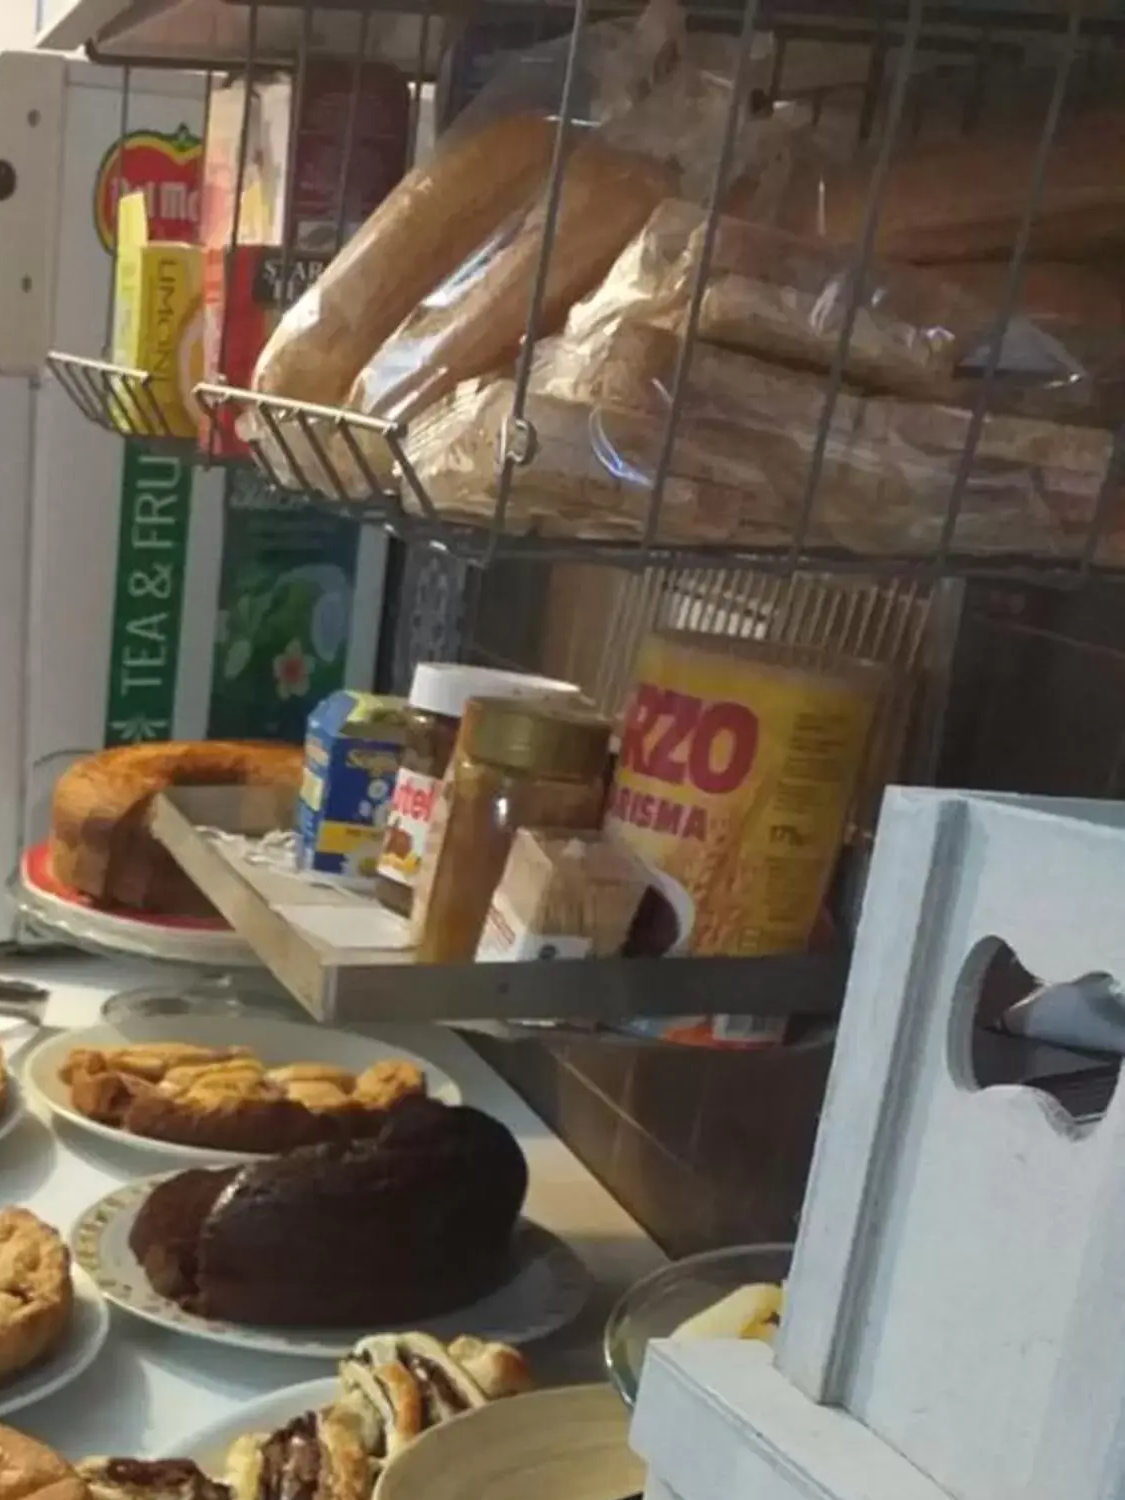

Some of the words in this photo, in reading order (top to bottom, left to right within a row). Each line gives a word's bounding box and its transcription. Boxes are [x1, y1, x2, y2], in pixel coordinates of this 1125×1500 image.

[131, 455, 181, 549] FRU
[128, 562, 173, 600] &
[121, 612, 169, 696] TEA
